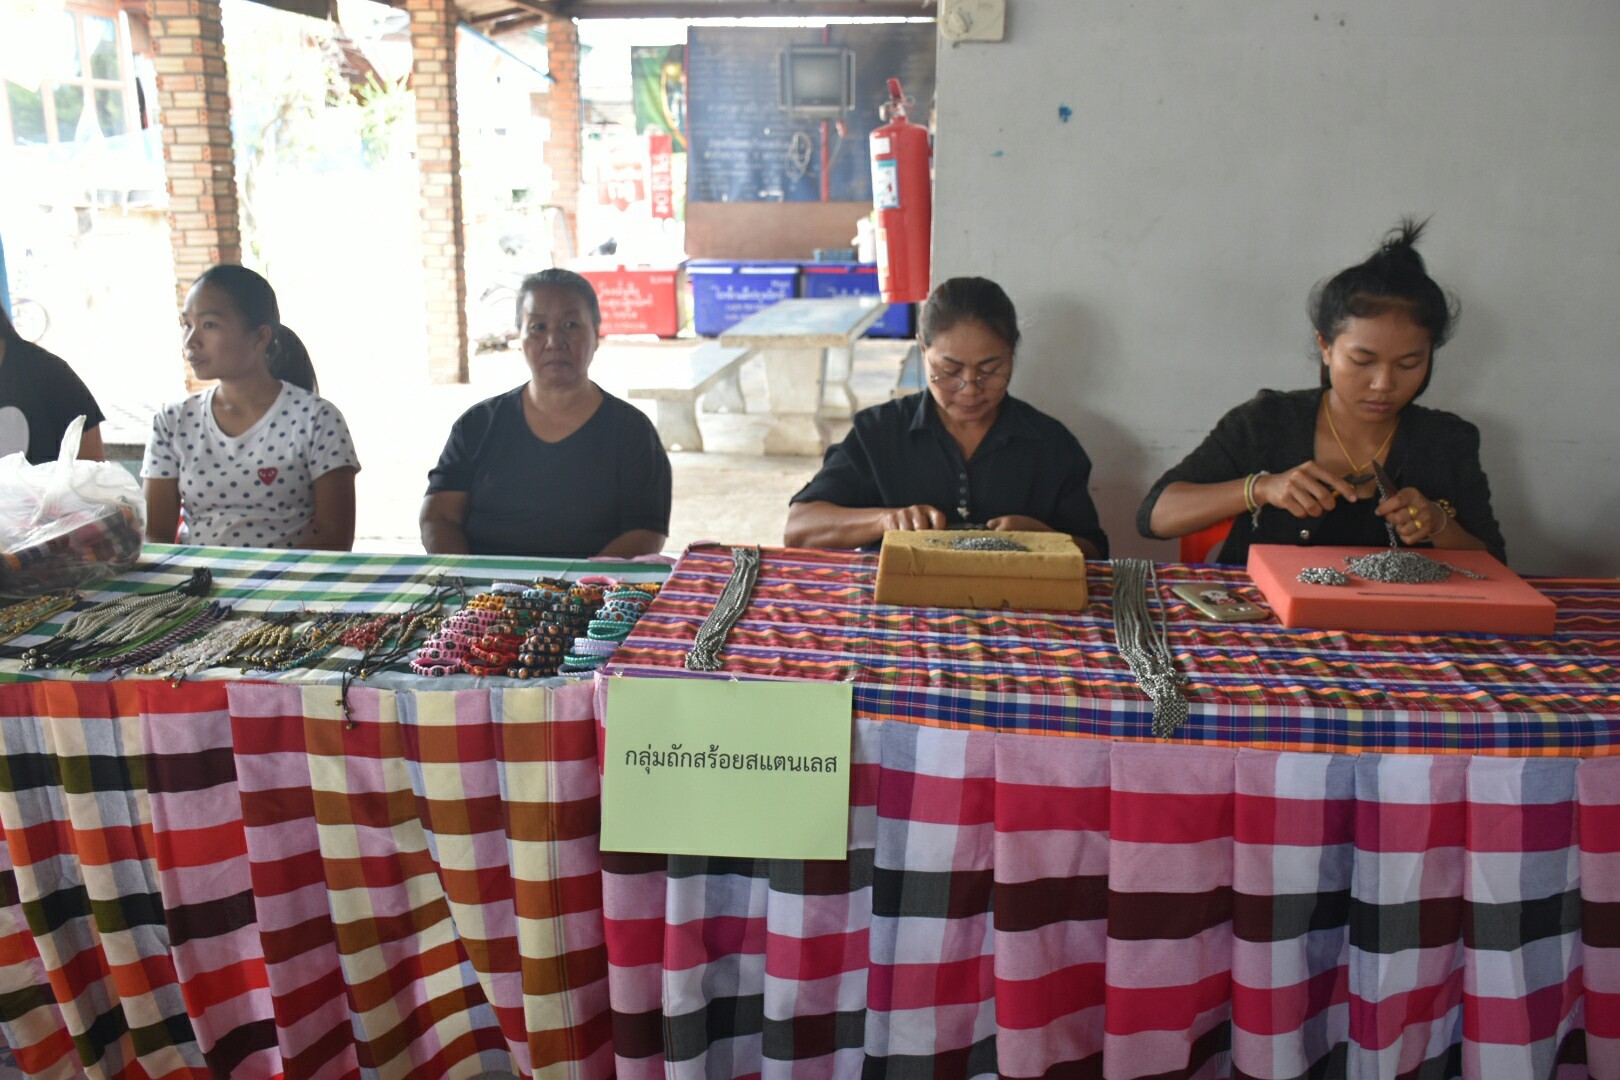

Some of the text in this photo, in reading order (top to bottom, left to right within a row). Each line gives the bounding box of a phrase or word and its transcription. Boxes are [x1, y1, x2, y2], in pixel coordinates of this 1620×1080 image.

[625, 743, 837, 775] กลุ่มถักสร้อยสแตนเลส
